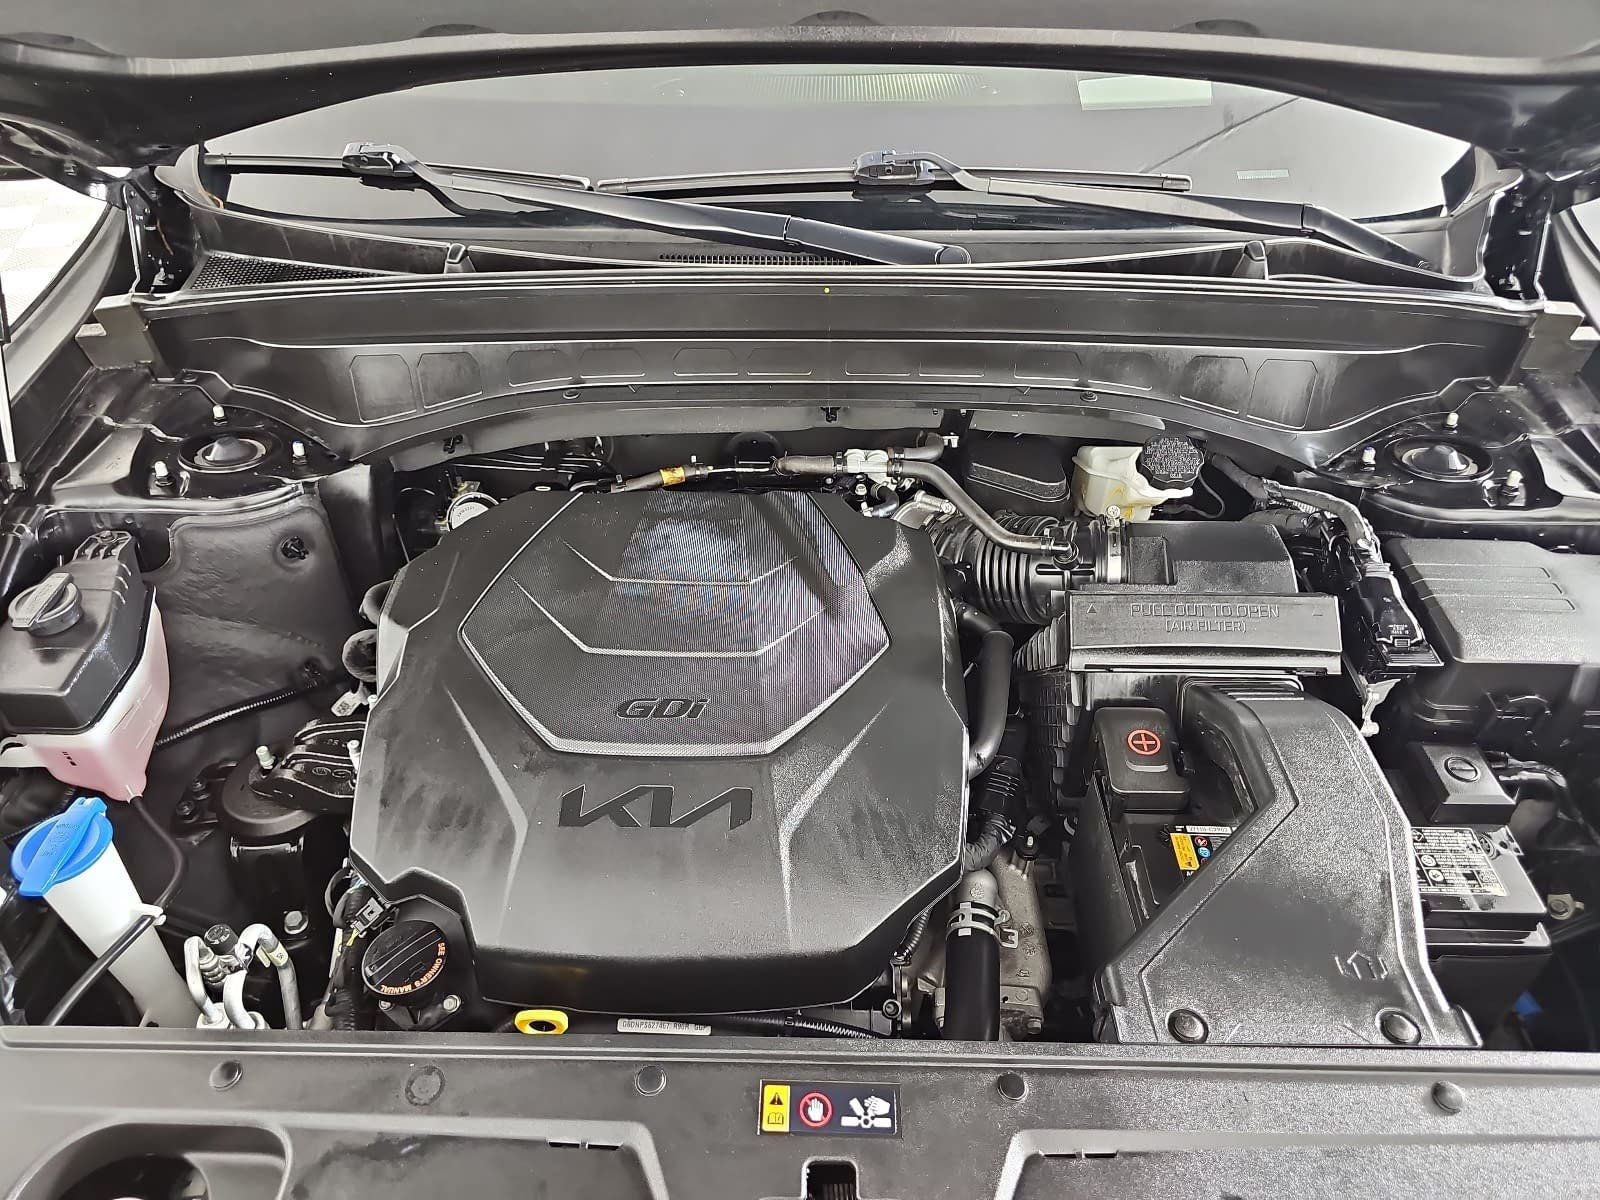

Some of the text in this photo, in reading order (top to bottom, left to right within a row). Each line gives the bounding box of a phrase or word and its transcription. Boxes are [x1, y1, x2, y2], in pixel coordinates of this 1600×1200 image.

[1130, 602, 1280, 618] PULL OUT TO OPEN
[1197, 619, 1247, 633] FILTER)
[616, 698, 711, 720] GDi
[558, 783, 753, 831] KIA
[380, 942, 446, 995] SEE OWNER'S MANUAL
